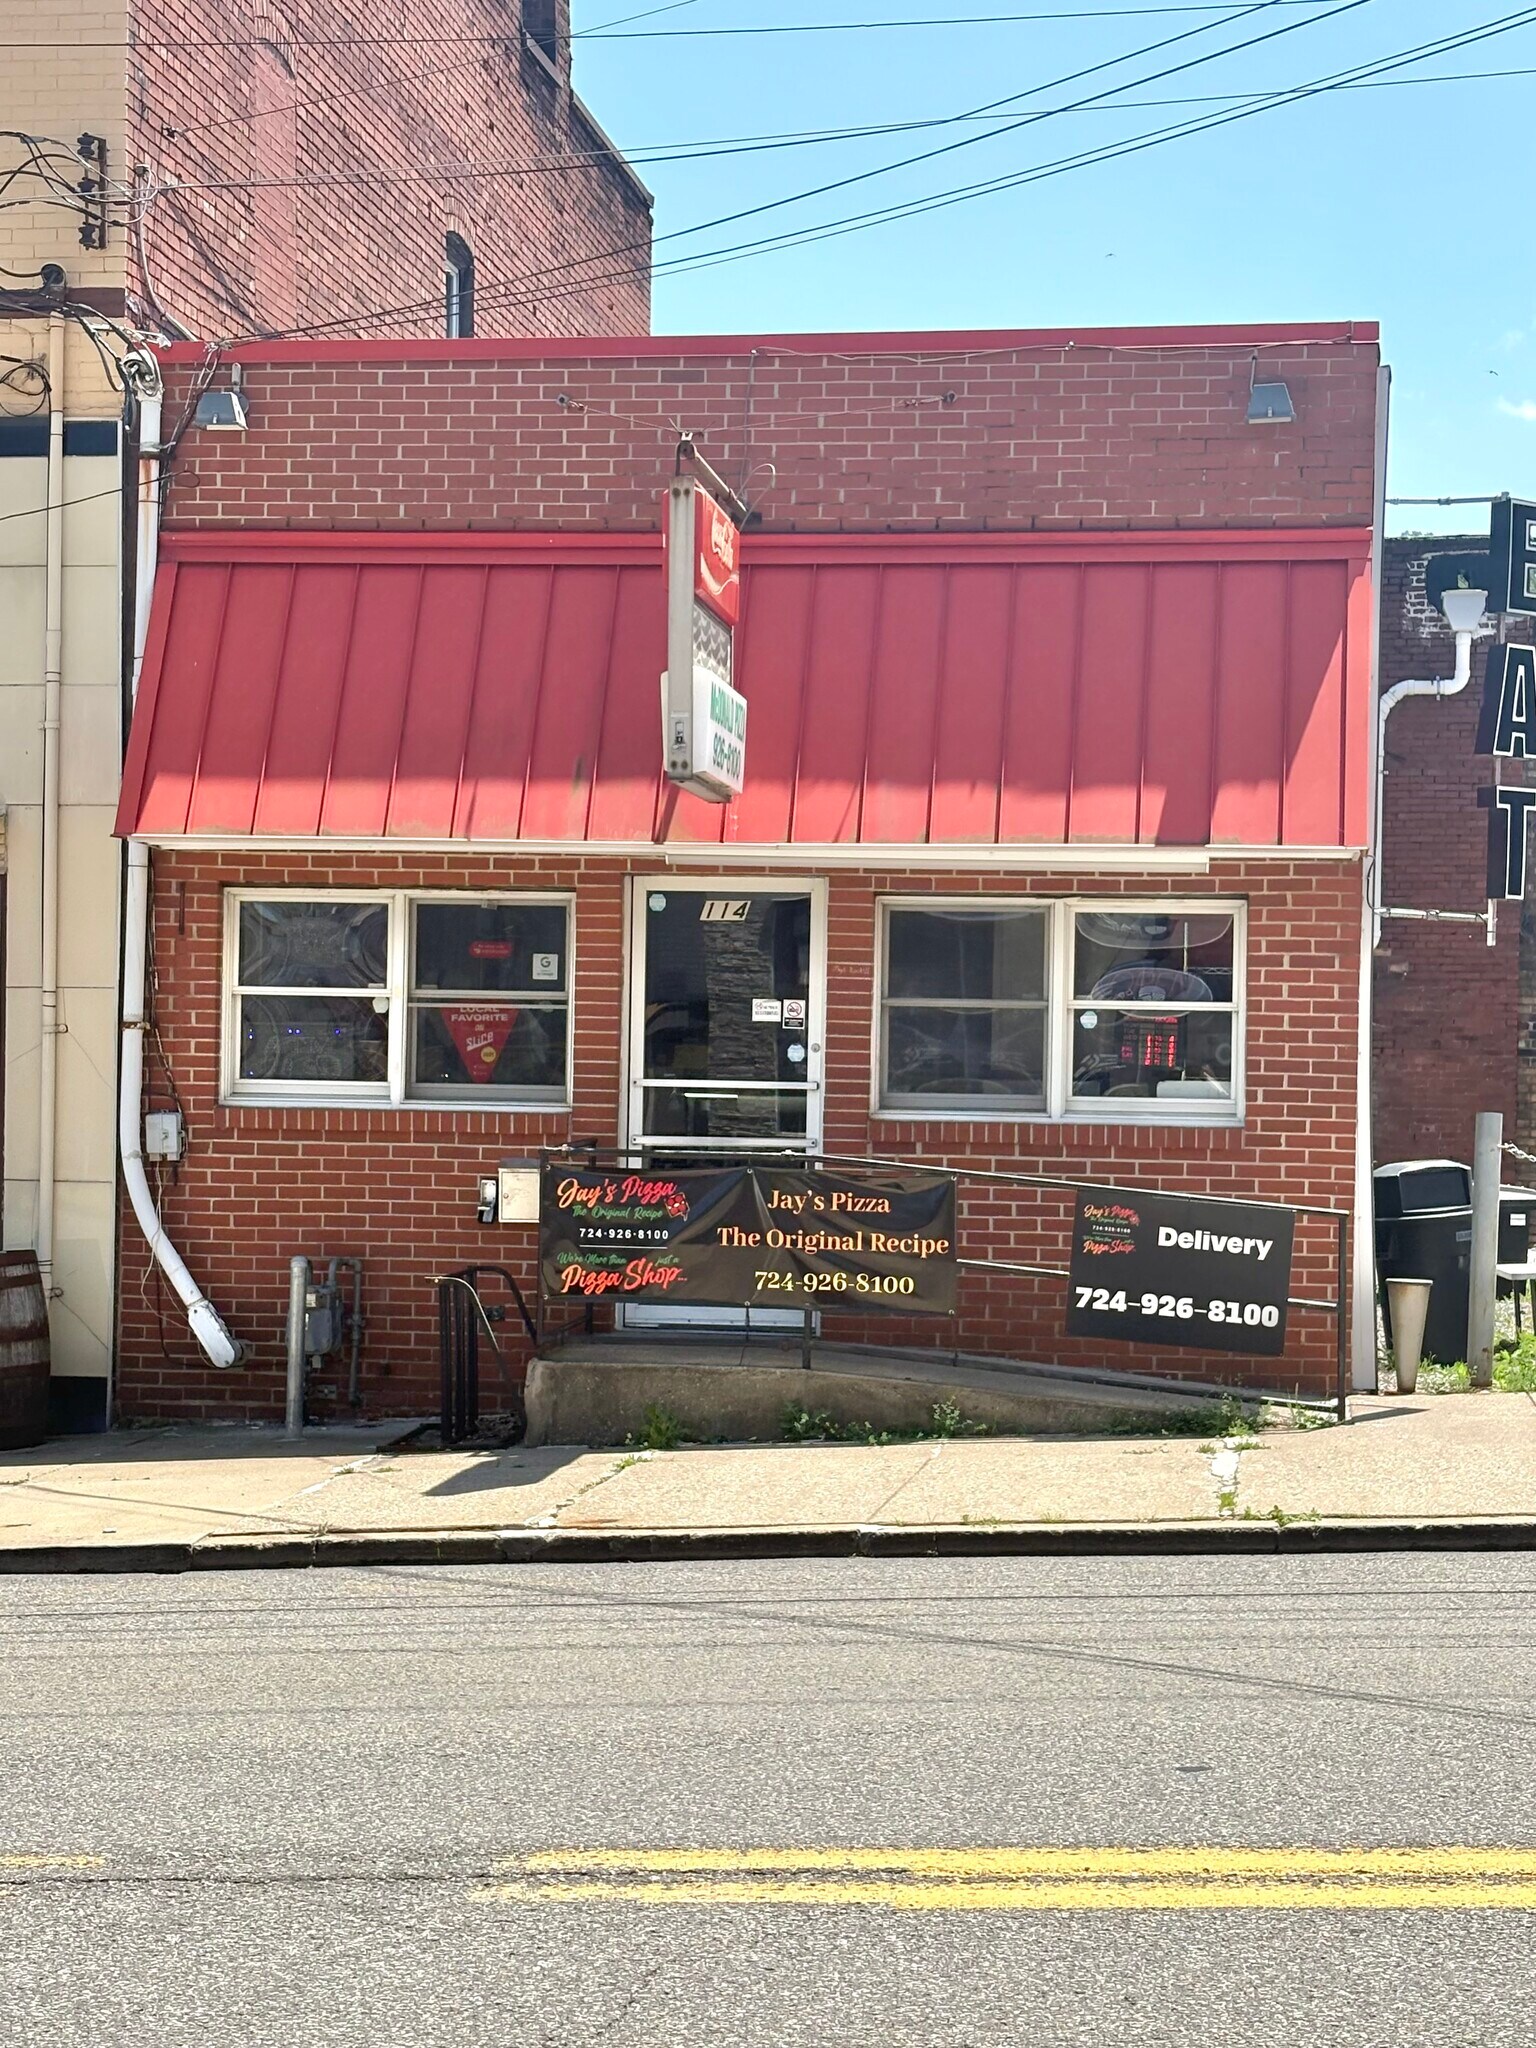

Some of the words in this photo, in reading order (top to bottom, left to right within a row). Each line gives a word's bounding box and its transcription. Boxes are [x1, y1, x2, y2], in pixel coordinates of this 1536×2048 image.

[713, 731, 741, 780] 926-8100
[706, 902, 749, 919] 114
[451, 1014, 509, 1022] FAVORITE
[557, 1178, 618, 1208] Jay's
[620, 1175, 677, 1204] Pizza
[767, 1190, 825, 1214] Jay's
[830, 1192, 891, 1213] Pizza
[572, 1205, 588, 1217] The
[591, 1205, 631, 1219] Original
[634, 1207, 663, 1220] Recipe
[1084, 1204, 1110, 1217] Jay's
[717, 1227, 761, 1248] The
[766, 1229, 862, 1255] Original
[870, 1232, 949, 1259] Recipe
[1157, 1226, 1273, 1260] Delivery
[561, 1264, 623, 1295] Pizza
[755, 1271, 914, 1294] 724-926-8100
[1075, 1286, 1279, 1328] 724-926-8100
